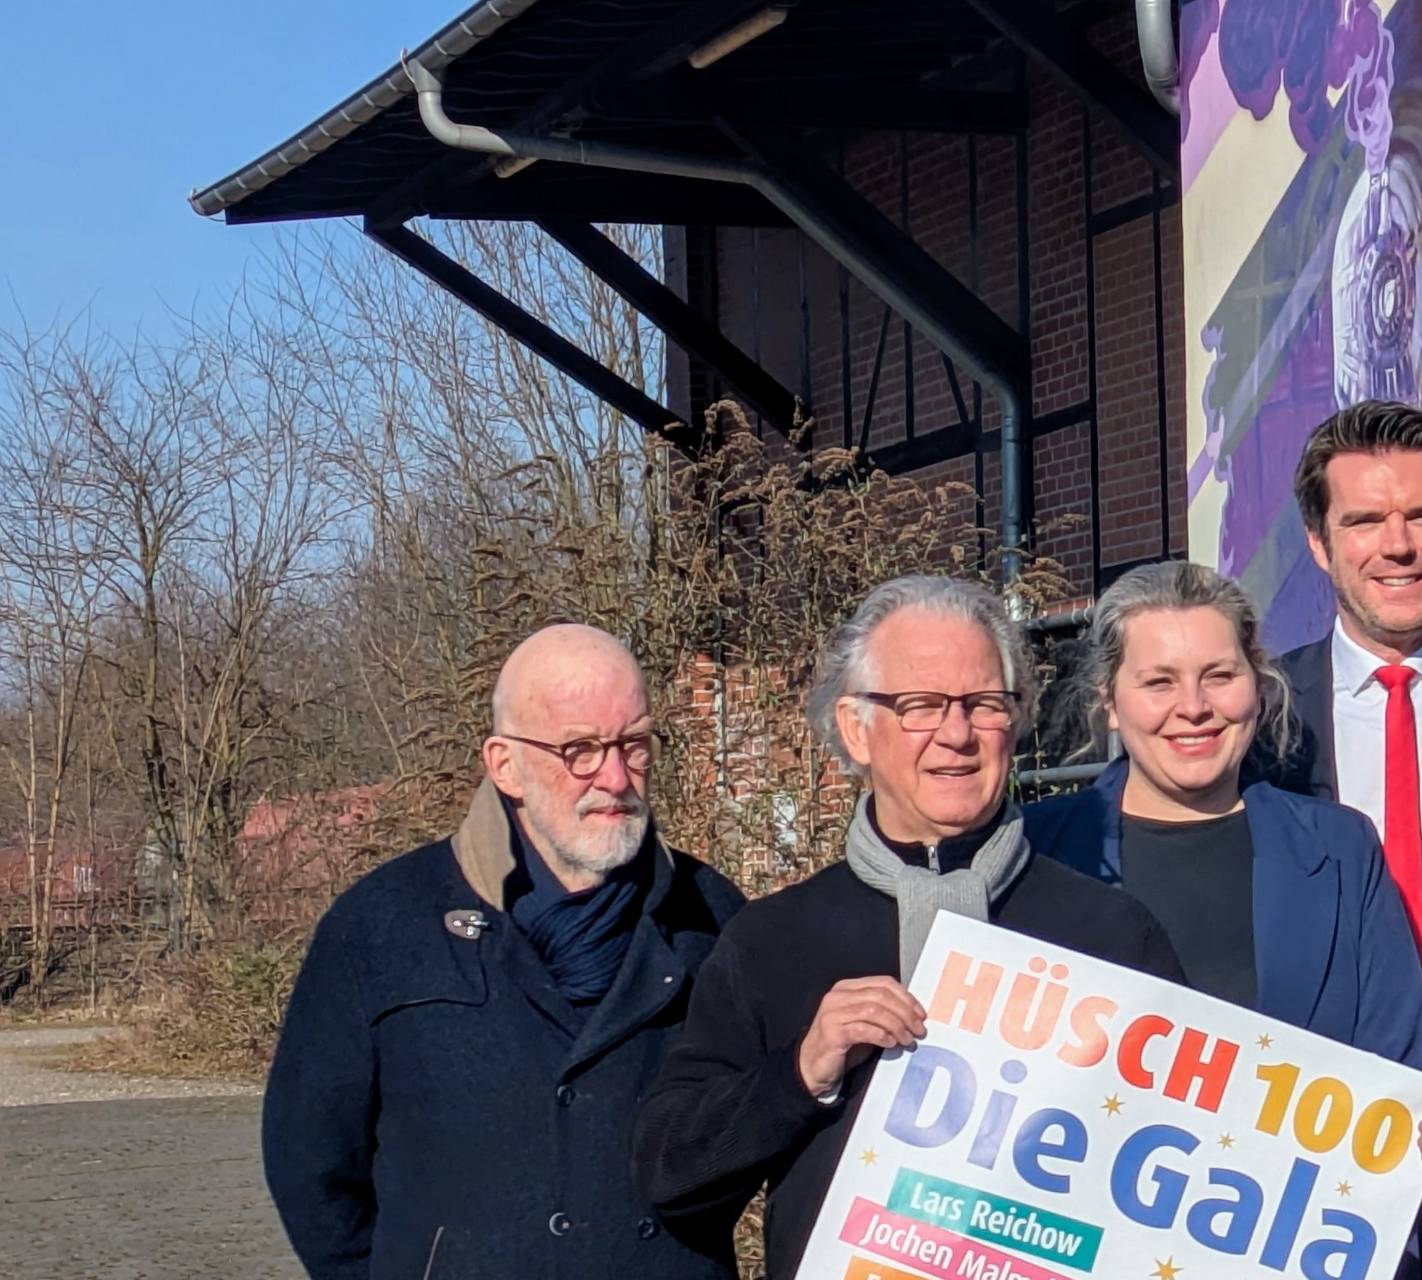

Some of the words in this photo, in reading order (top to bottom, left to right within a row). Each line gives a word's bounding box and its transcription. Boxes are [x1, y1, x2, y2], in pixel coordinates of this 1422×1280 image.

[926, 951, 1241, 1114] HÜSCH
[1254, 1062, 1414, 1175] 100
[883, 1043, 1089, 1194] Die
[1110, 1123, 1378, 1280] Gala
[910, 1182, 966, 1221] Lars
[969, 1200, 1084, 1258] Reichow
[858, 1214, 954, 1270] Jochen
